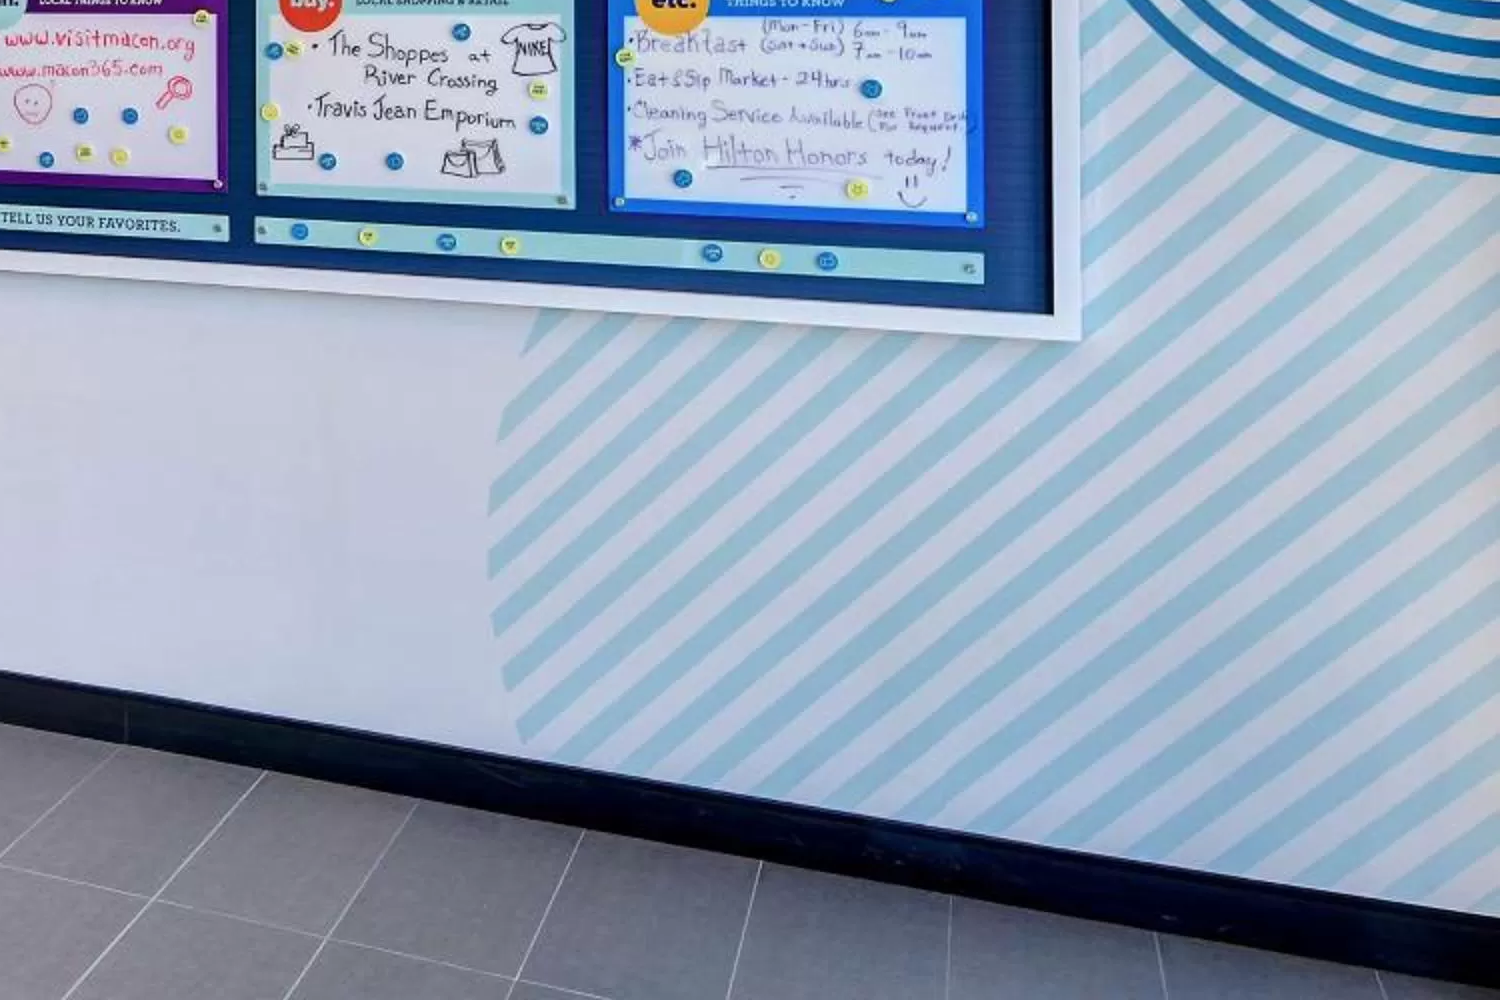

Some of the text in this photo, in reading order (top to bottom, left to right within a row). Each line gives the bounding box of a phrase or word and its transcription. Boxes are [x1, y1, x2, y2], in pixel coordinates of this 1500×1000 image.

[5, 29, 196, 62] www.visitmacon.org
[328, 28, 492, 67] The Shoppes at
[518, 39, 549, 58] NIKE
[364, 64, 499, 97] River Crossing
[719, 66, 777, 88] Market
[314, 92, 517, 132] Travis Jean Emporium
[710, 98, 784, 124] Service
[643, 127, 953, 178] Join Hilton Honors today!
[0, 212, 182, 234] TELL US YOUR FAVORITES.
